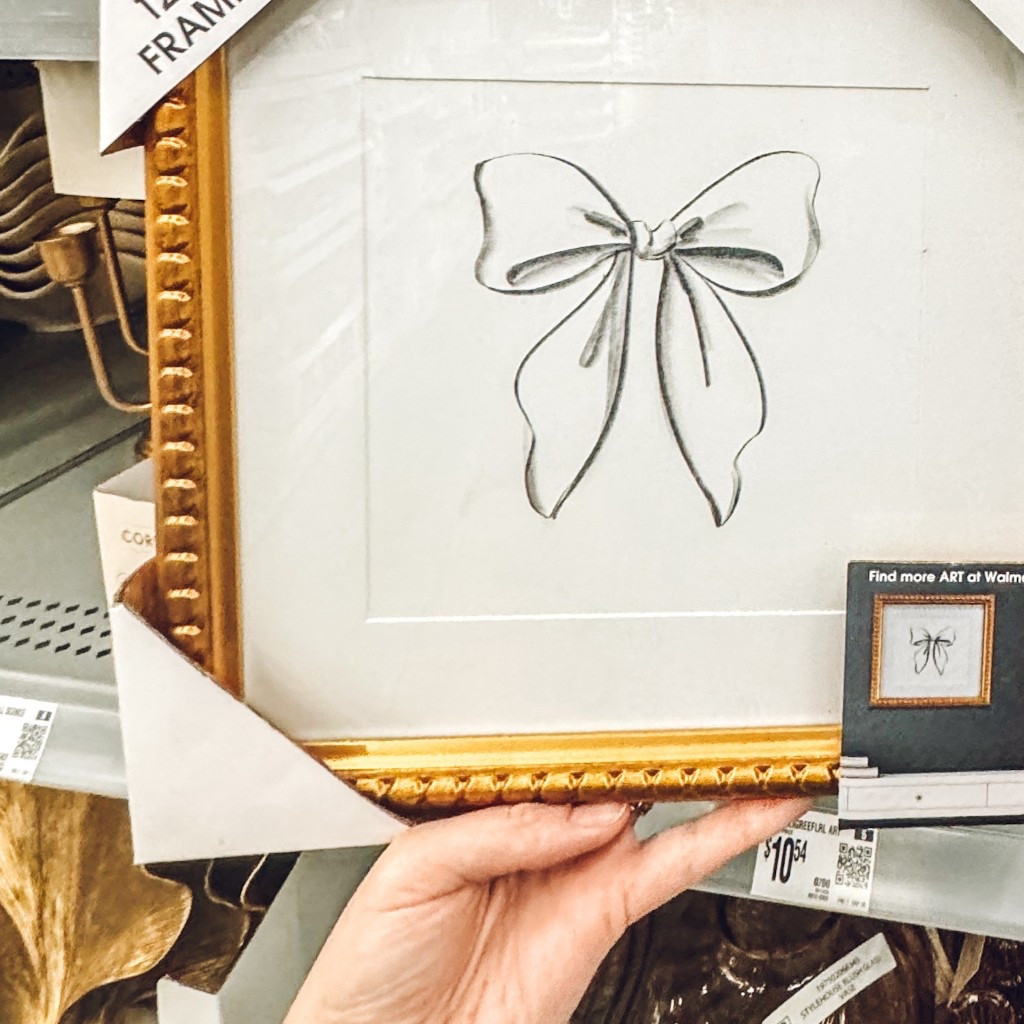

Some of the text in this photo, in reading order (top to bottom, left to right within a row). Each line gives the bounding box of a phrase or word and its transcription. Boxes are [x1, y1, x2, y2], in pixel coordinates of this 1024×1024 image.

[868, 570, 897, 583] Find
[900, 572, 936, 583] more
[939, 571, 964, 583] ART
[967, 571, 981, 583] at
[838, 983, 857, 999] VASE
[800, 983, 843, 1020] STYLEHOUSE
